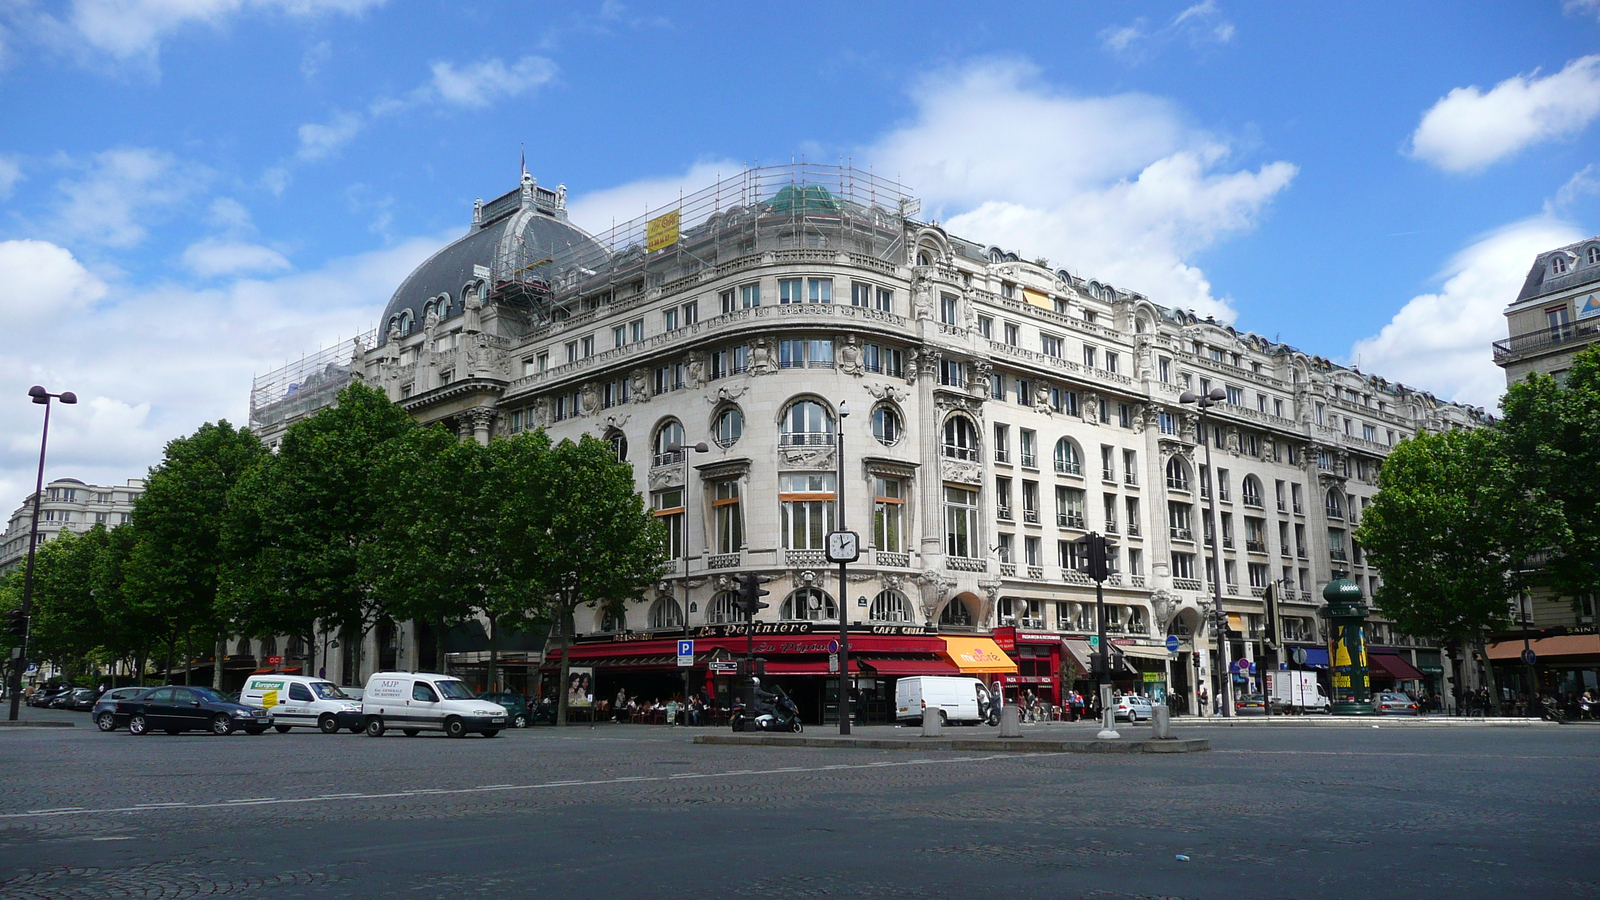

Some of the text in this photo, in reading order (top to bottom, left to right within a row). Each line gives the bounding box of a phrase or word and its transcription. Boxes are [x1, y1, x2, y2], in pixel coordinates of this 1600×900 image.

[697, 626, 717, 637] La
[901, 627, 926, 635] GRILL
[1566, 626, 1597, 634] SAINT
[682, 643, 690, 654] P
[754, 642, 776, 652] La
[254, 681, 282, 689] Europcar
[381, 680, 400, 688] MJP
